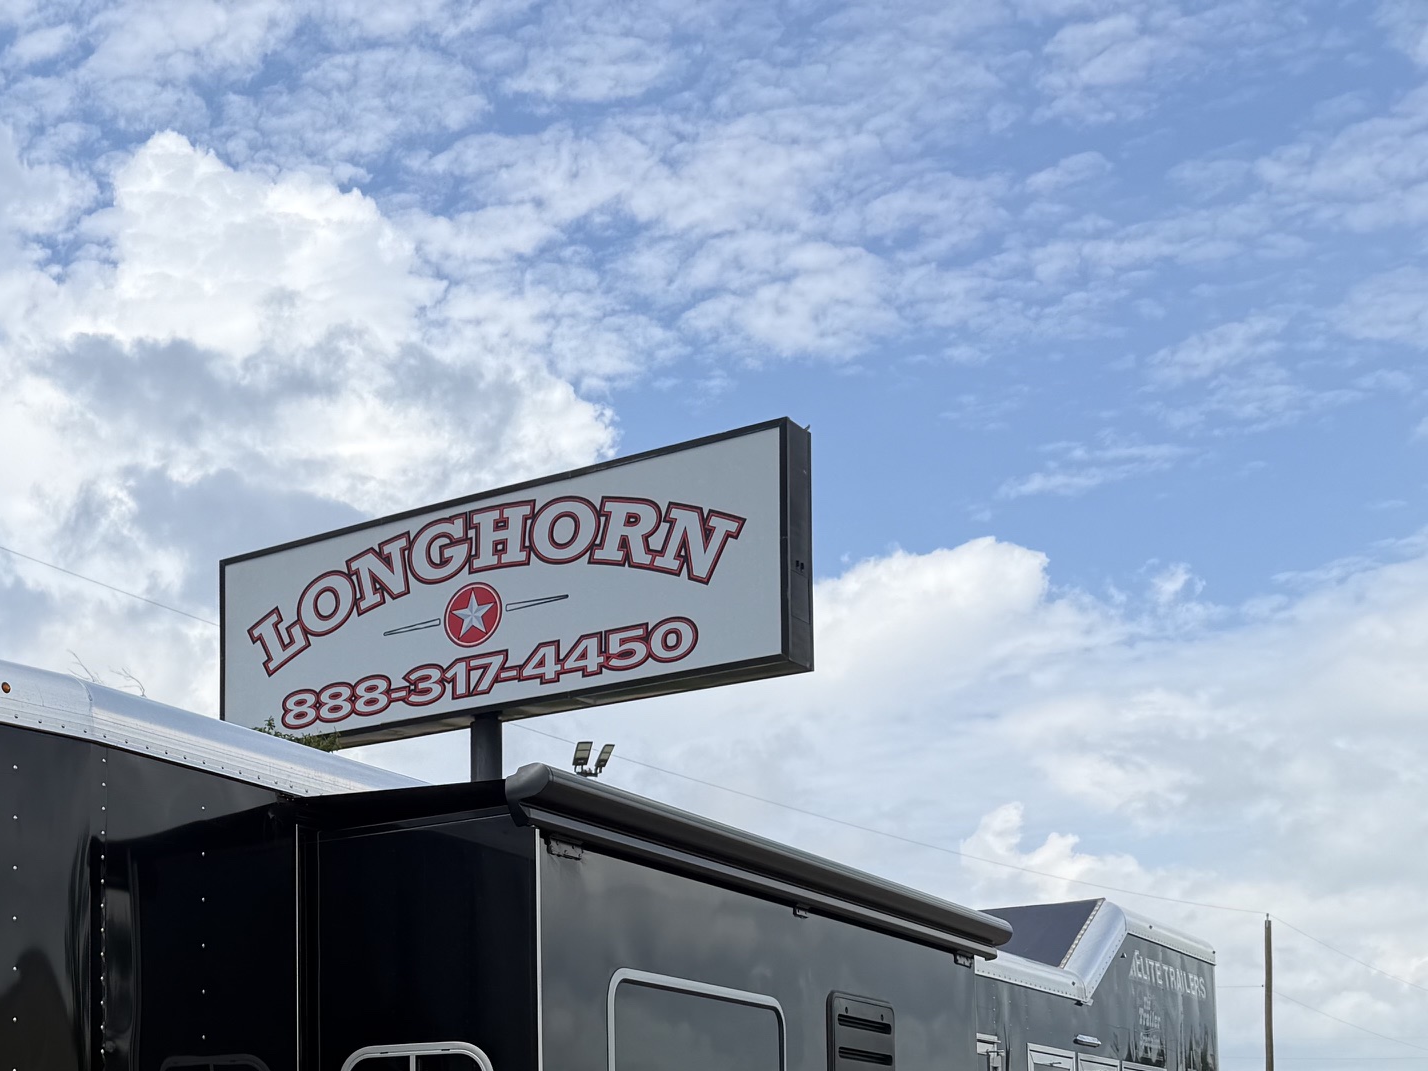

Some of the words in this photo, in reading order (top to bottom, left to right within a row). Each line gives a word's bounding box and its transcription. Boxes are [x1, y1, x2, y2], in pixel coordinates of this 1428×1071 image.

[248, 495, 747, 677] LONGHORN
[282, 616, 699, 729] 888-317-4450
[1129, 950, 1163, 985] ELITE
[1162, 964, 1207, 999] TRAILERS
